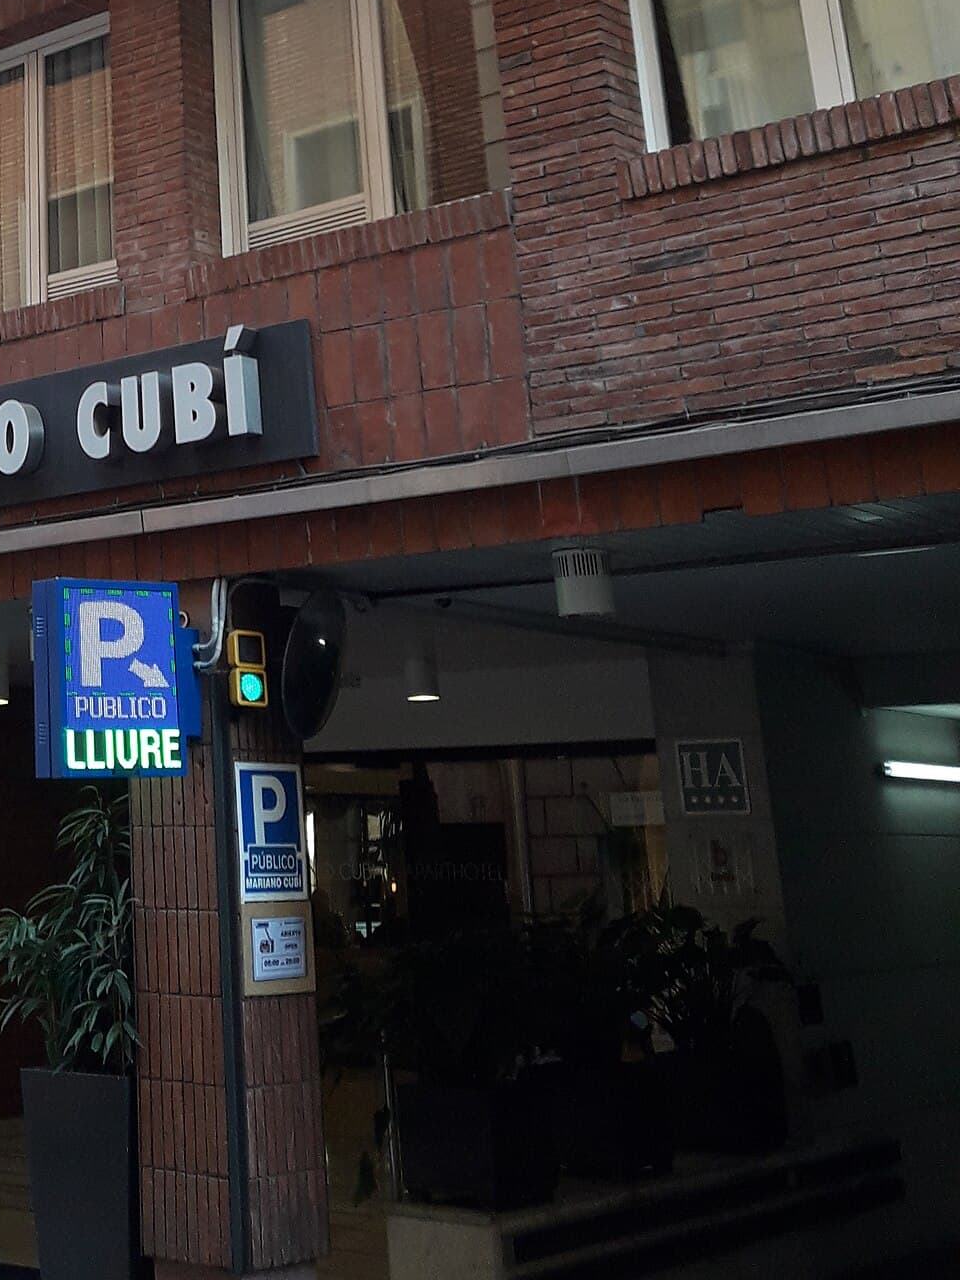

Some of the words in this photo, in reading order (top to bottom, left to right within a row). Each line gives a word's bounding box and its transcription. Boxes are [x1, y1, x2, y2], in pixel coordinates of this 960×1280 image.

[75, 323, 264, 460] CUBÍ
[79, 601, 144, 688] P
[65, 728, 183, 770] LLIURE
[681, 751, 742, 788] HA
[251, 774, 287, 845] P
[251, 850, 295, 870] PÚBLICO
[245, 877, 282, 889] MARIANO
